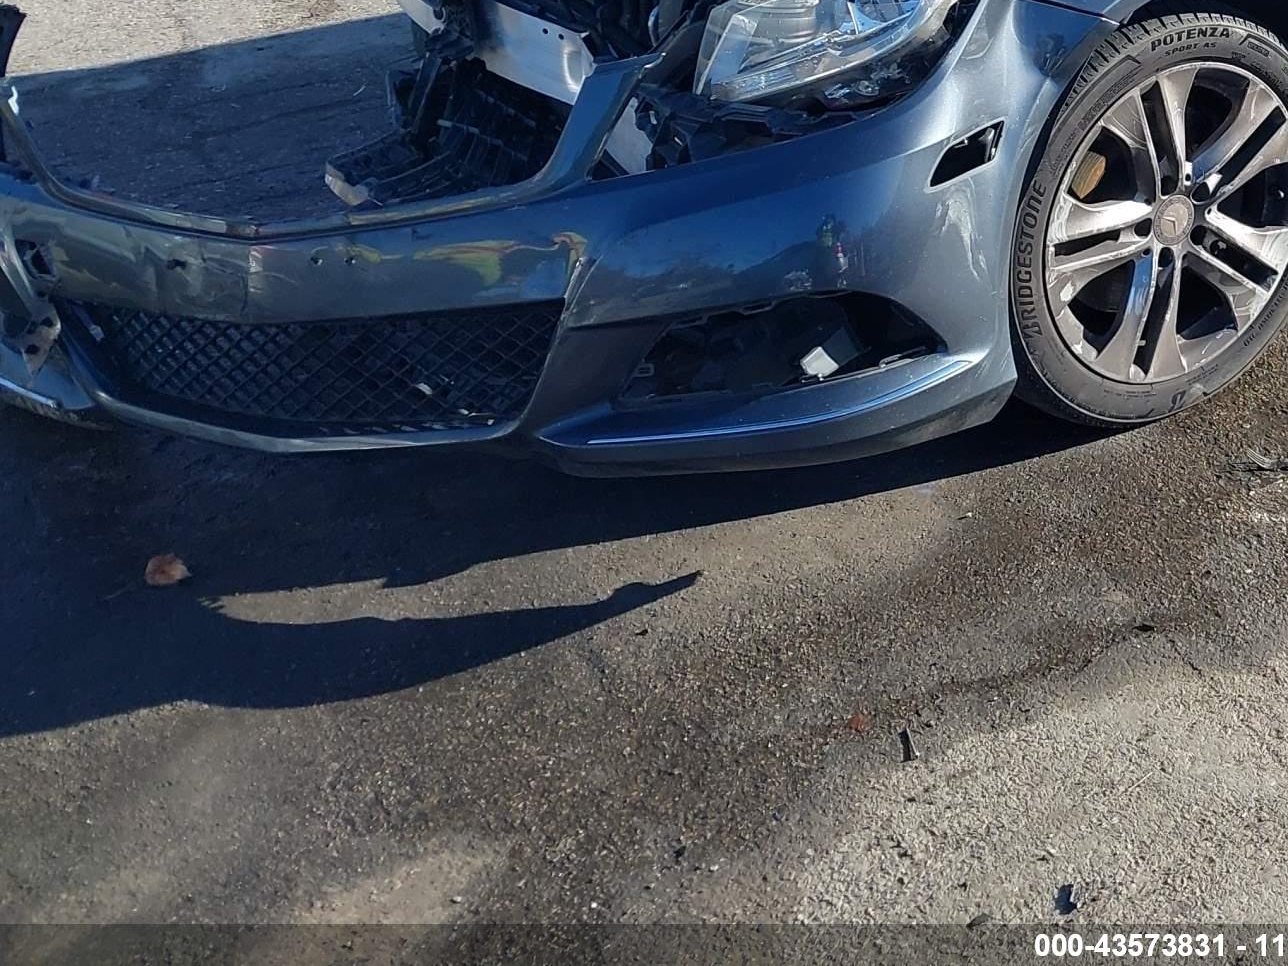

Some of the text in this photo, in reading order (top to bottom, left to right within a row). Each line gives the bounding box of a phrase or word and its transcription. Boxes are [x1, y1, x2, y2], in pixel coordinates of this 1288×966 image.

[1151, 27, 1230, 52] POTENZA
[1164, 42, 1200, 56] SPORT
[1016, 179, 1047, 341] BRIDGESTONE
